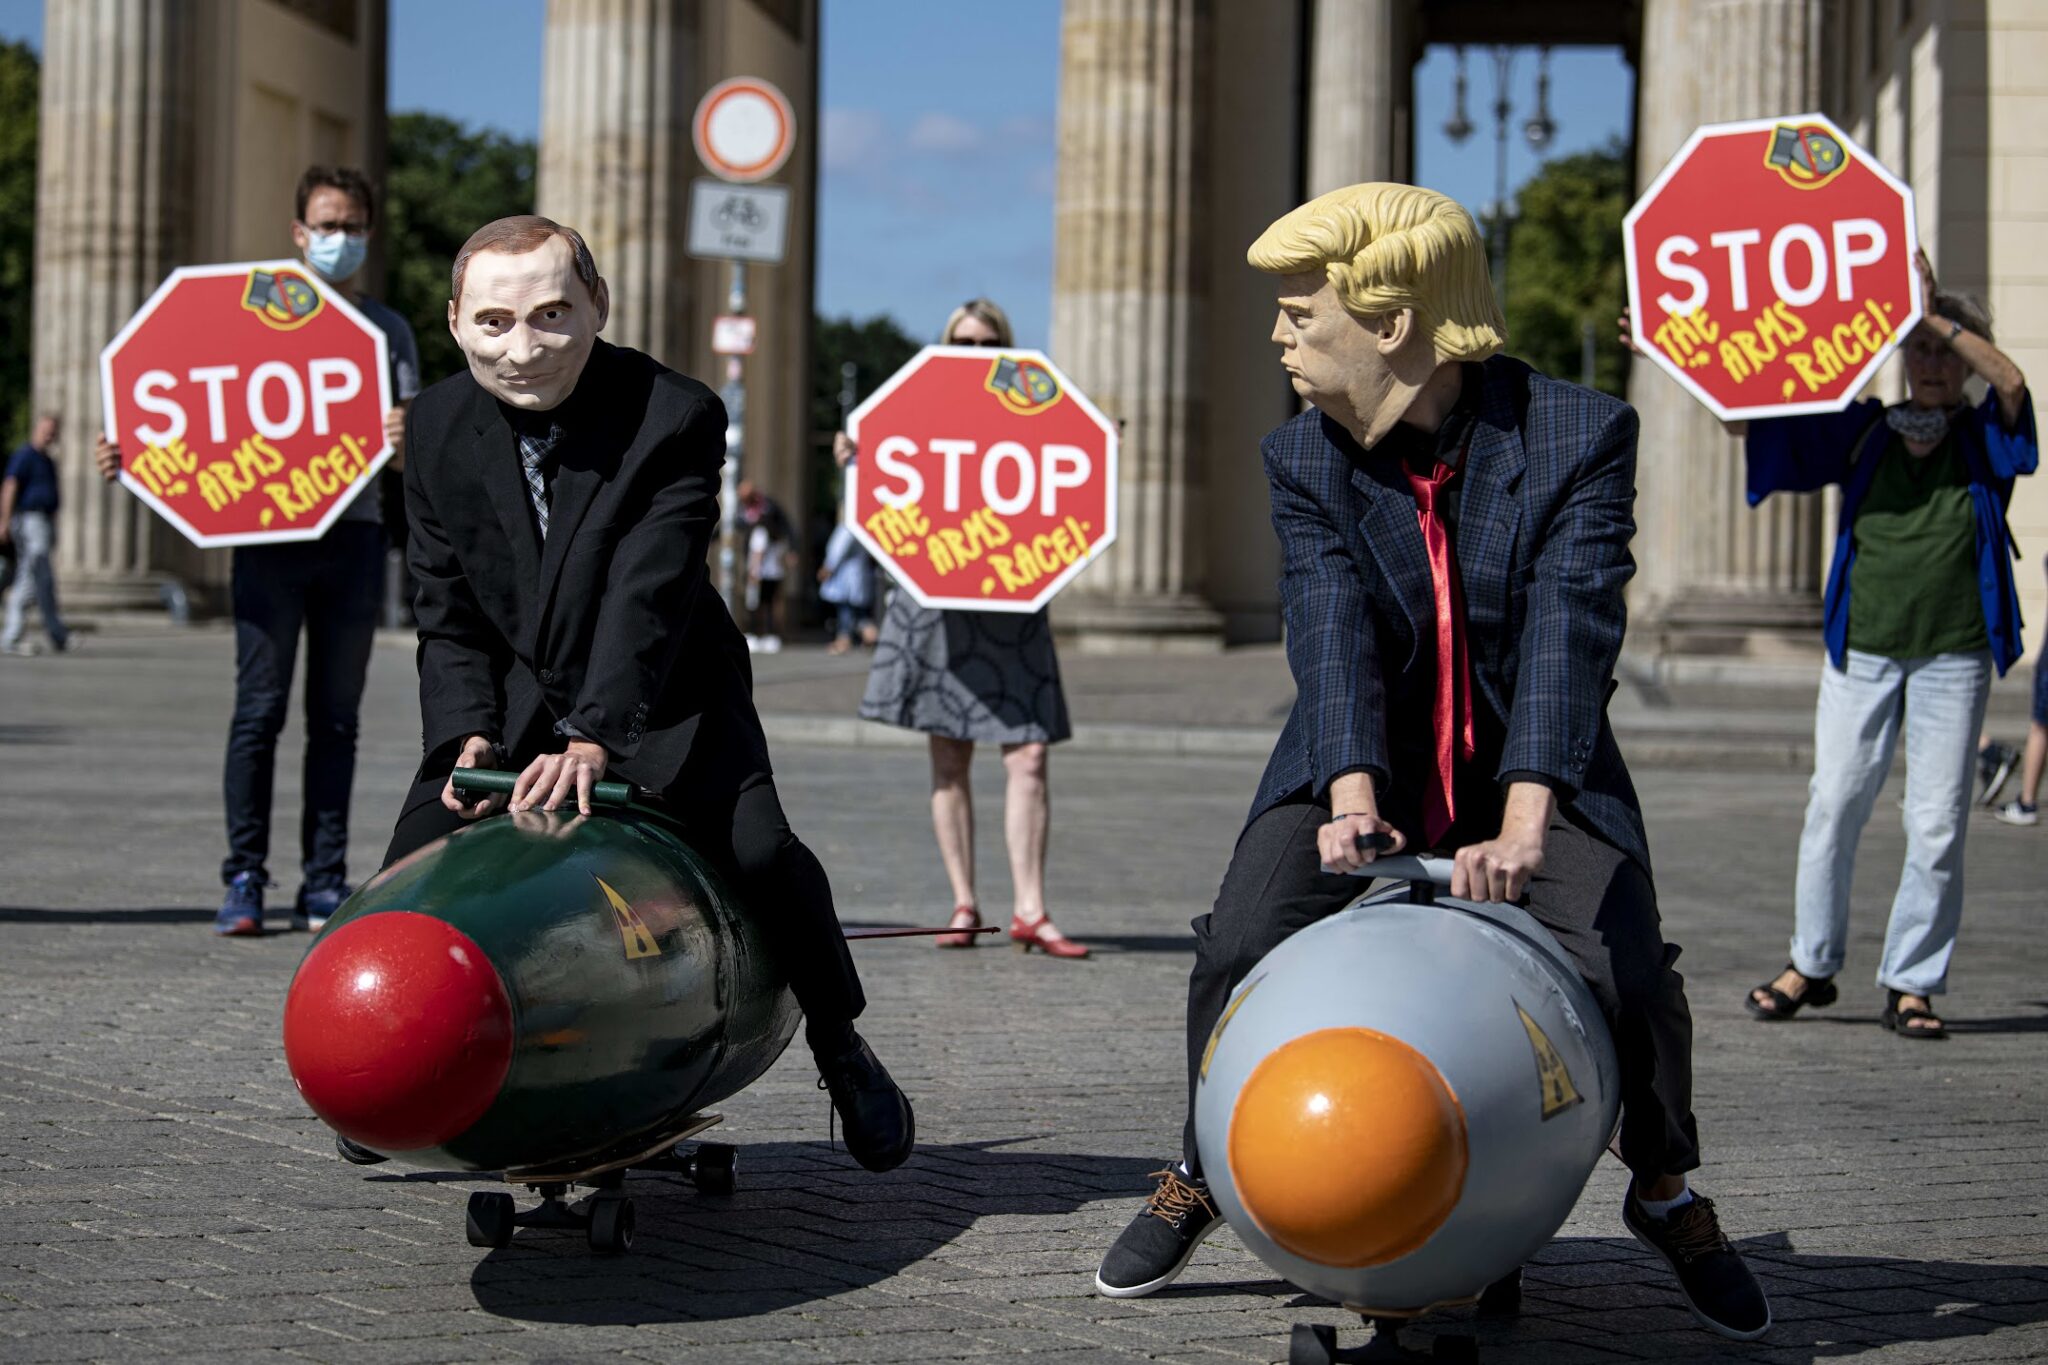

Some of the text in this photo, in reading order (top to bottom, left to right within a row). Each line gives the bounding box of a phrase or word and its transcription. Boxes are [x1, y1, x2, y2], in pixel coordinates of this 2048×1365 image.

[1656, 218, 1887, 316] STOP
[1654, 298, 1897, 393] THE ARMS RACE!
[133, 357, 363, 448] STOP
[130, 433, 370, 521] THE ARMS RACE!
[873, 436, 1092, 517] STOP
[865, 502, 1092, 594] THE ARMS RACE!
